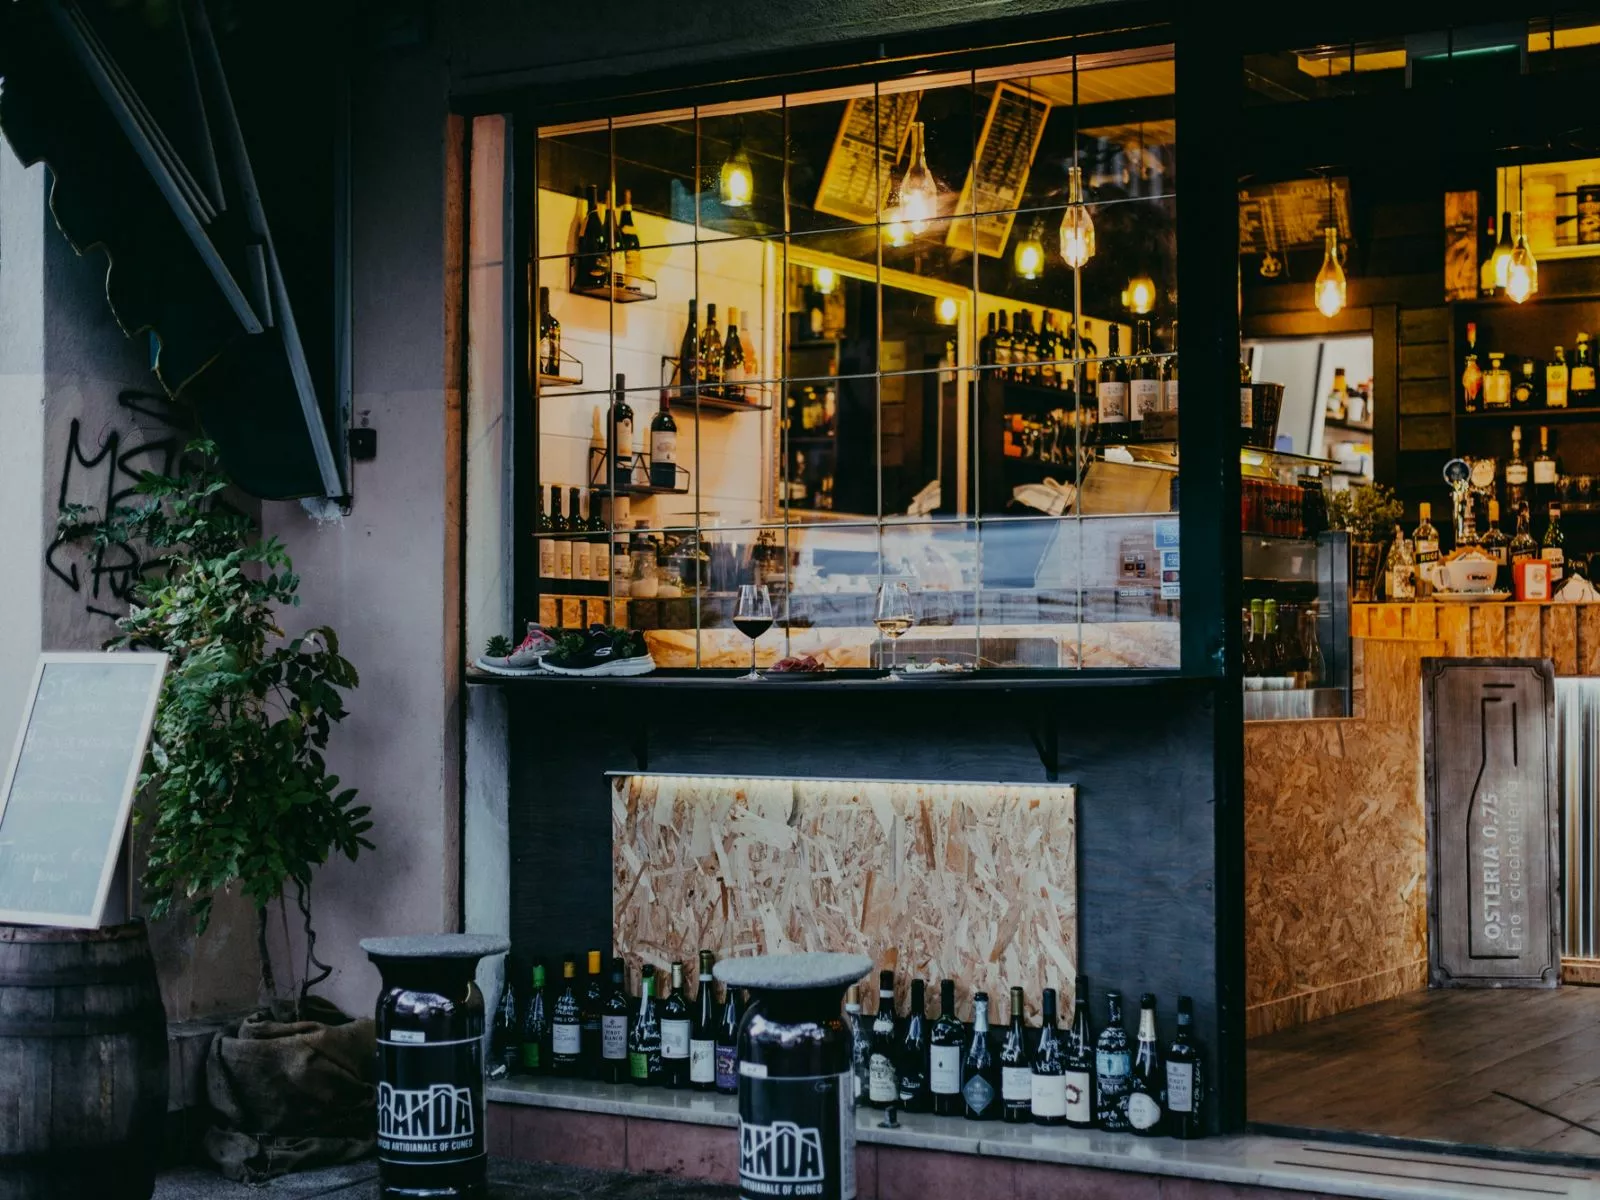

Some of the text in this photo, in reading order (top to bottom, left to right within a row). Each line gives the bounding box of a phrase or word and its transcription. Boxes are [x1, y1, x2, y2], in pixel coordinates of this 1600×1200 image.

[1481, 791, 1502, 940] OSTERIA 0.75
[1505, 913, 1523, 952] Eno
[391, 1141, 438, 1153] ARTIGIANALE
[440, 1141, 449, 1152] OF
[451, 1138, 473, 1151] CUNEO
[739, 1121, 824, 1182] ANDA
[782, 1184, 793, 1196] OF
[795, 1183, 823, 1196] CUNEO
